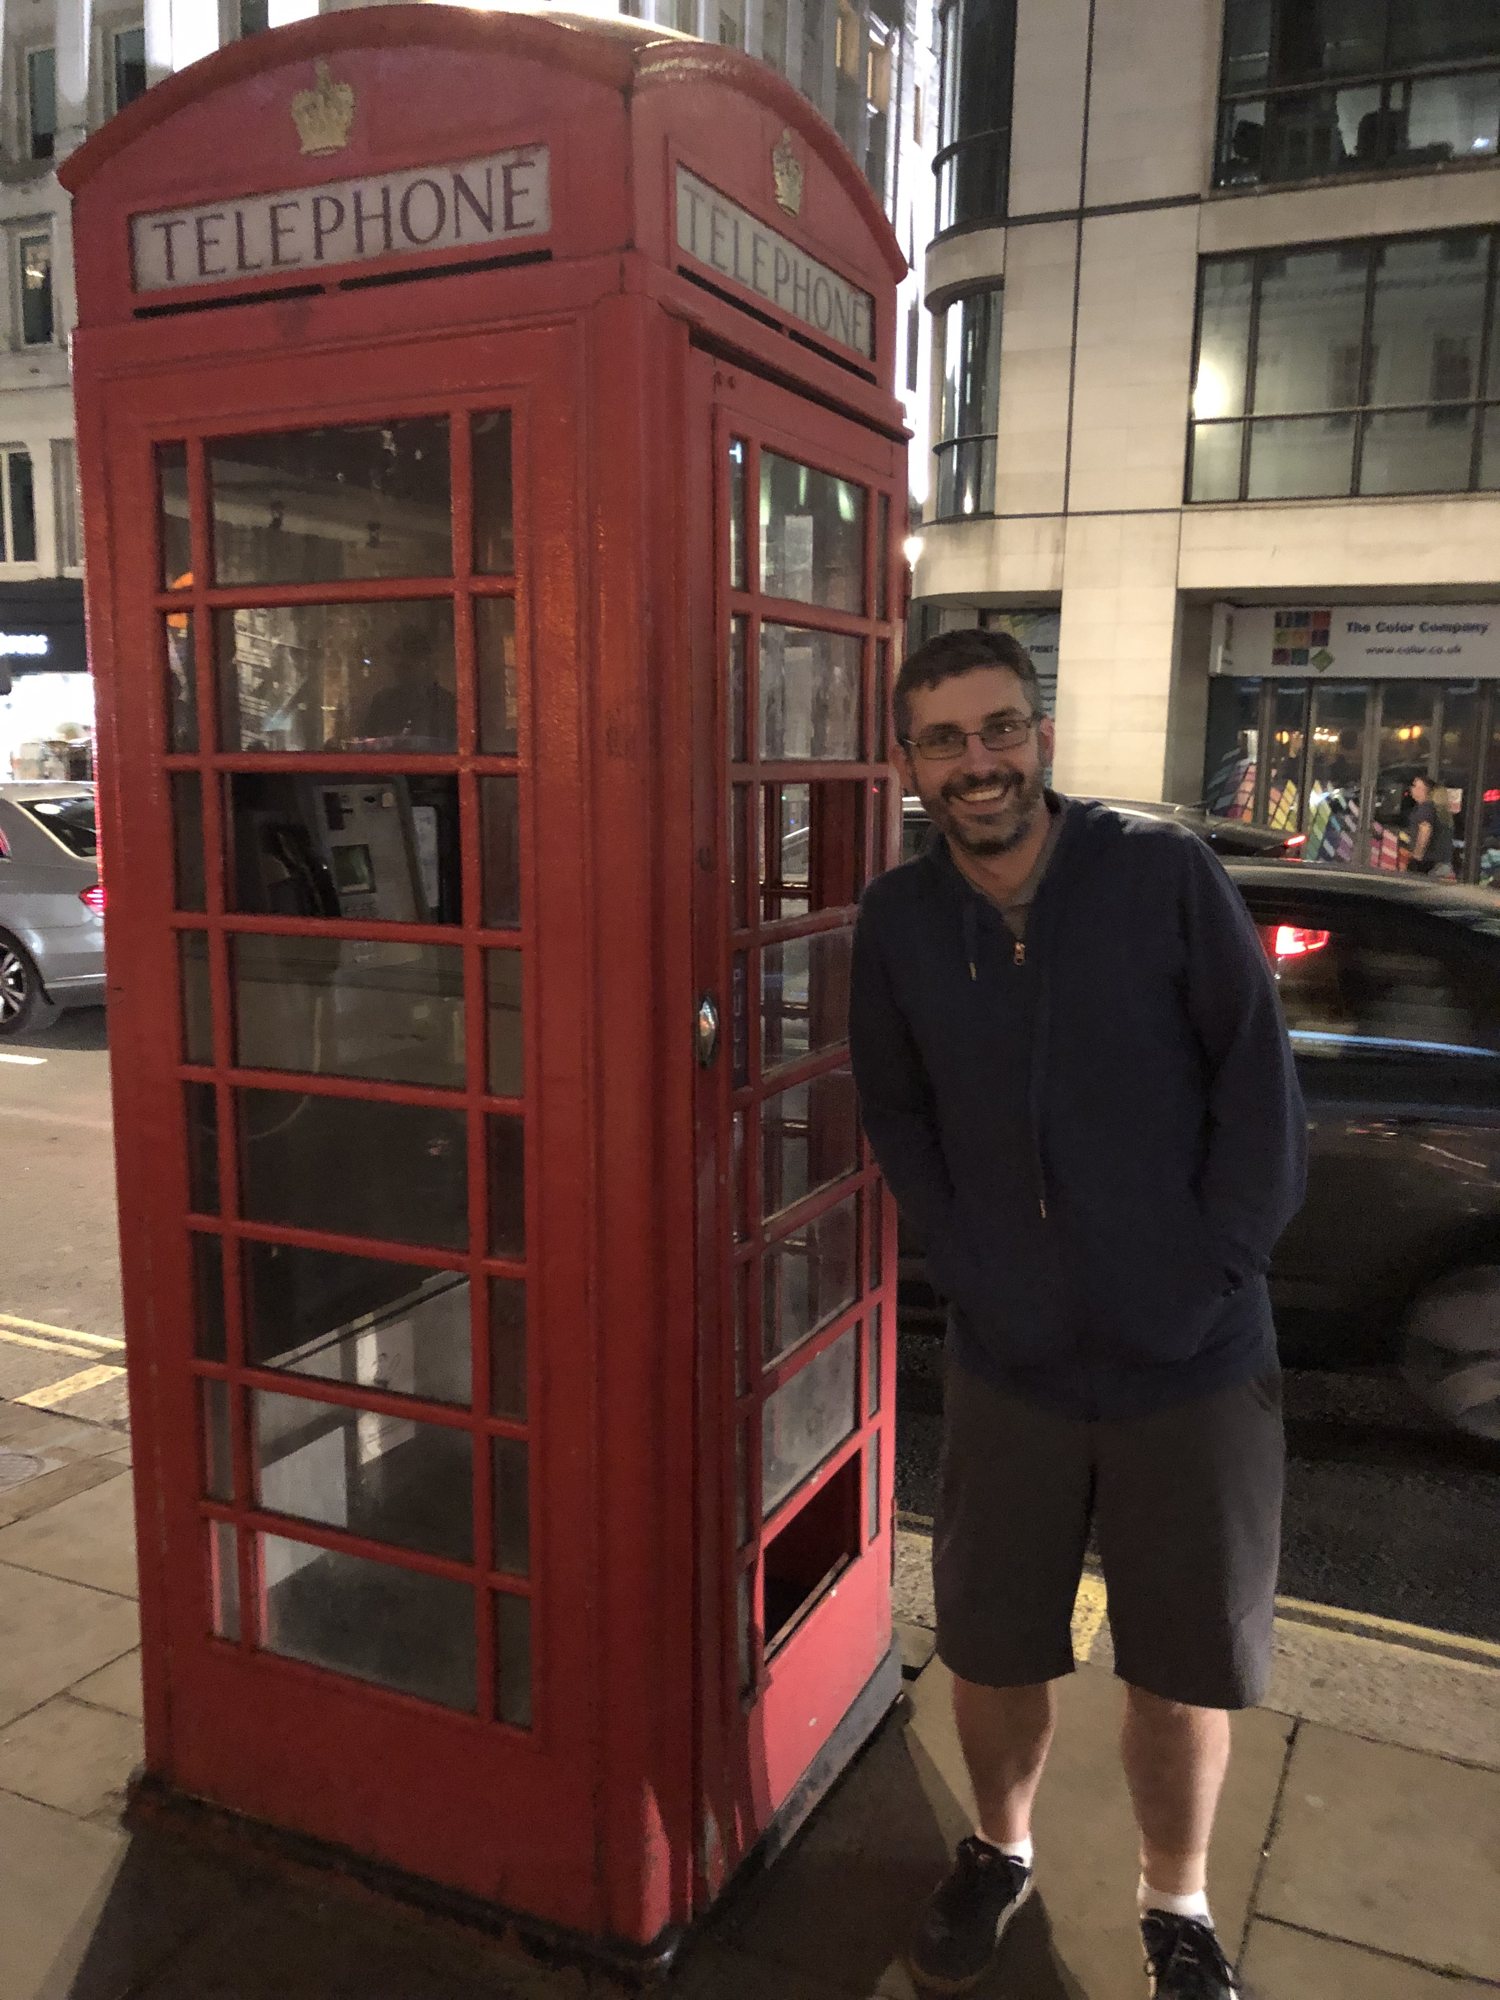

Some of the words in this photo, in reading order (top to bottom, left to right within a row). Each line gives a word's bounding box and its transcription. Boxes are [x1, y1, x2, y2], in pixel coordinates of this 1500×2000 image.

[152, 160, 537, 281] TELEPHONE
[683, 184, 864, 353] TELEPHONE
[1346, 621, 1371, 633] The
[1376, 621, 1414, 633] Color
[1419, 621, 1489, 636] Company
